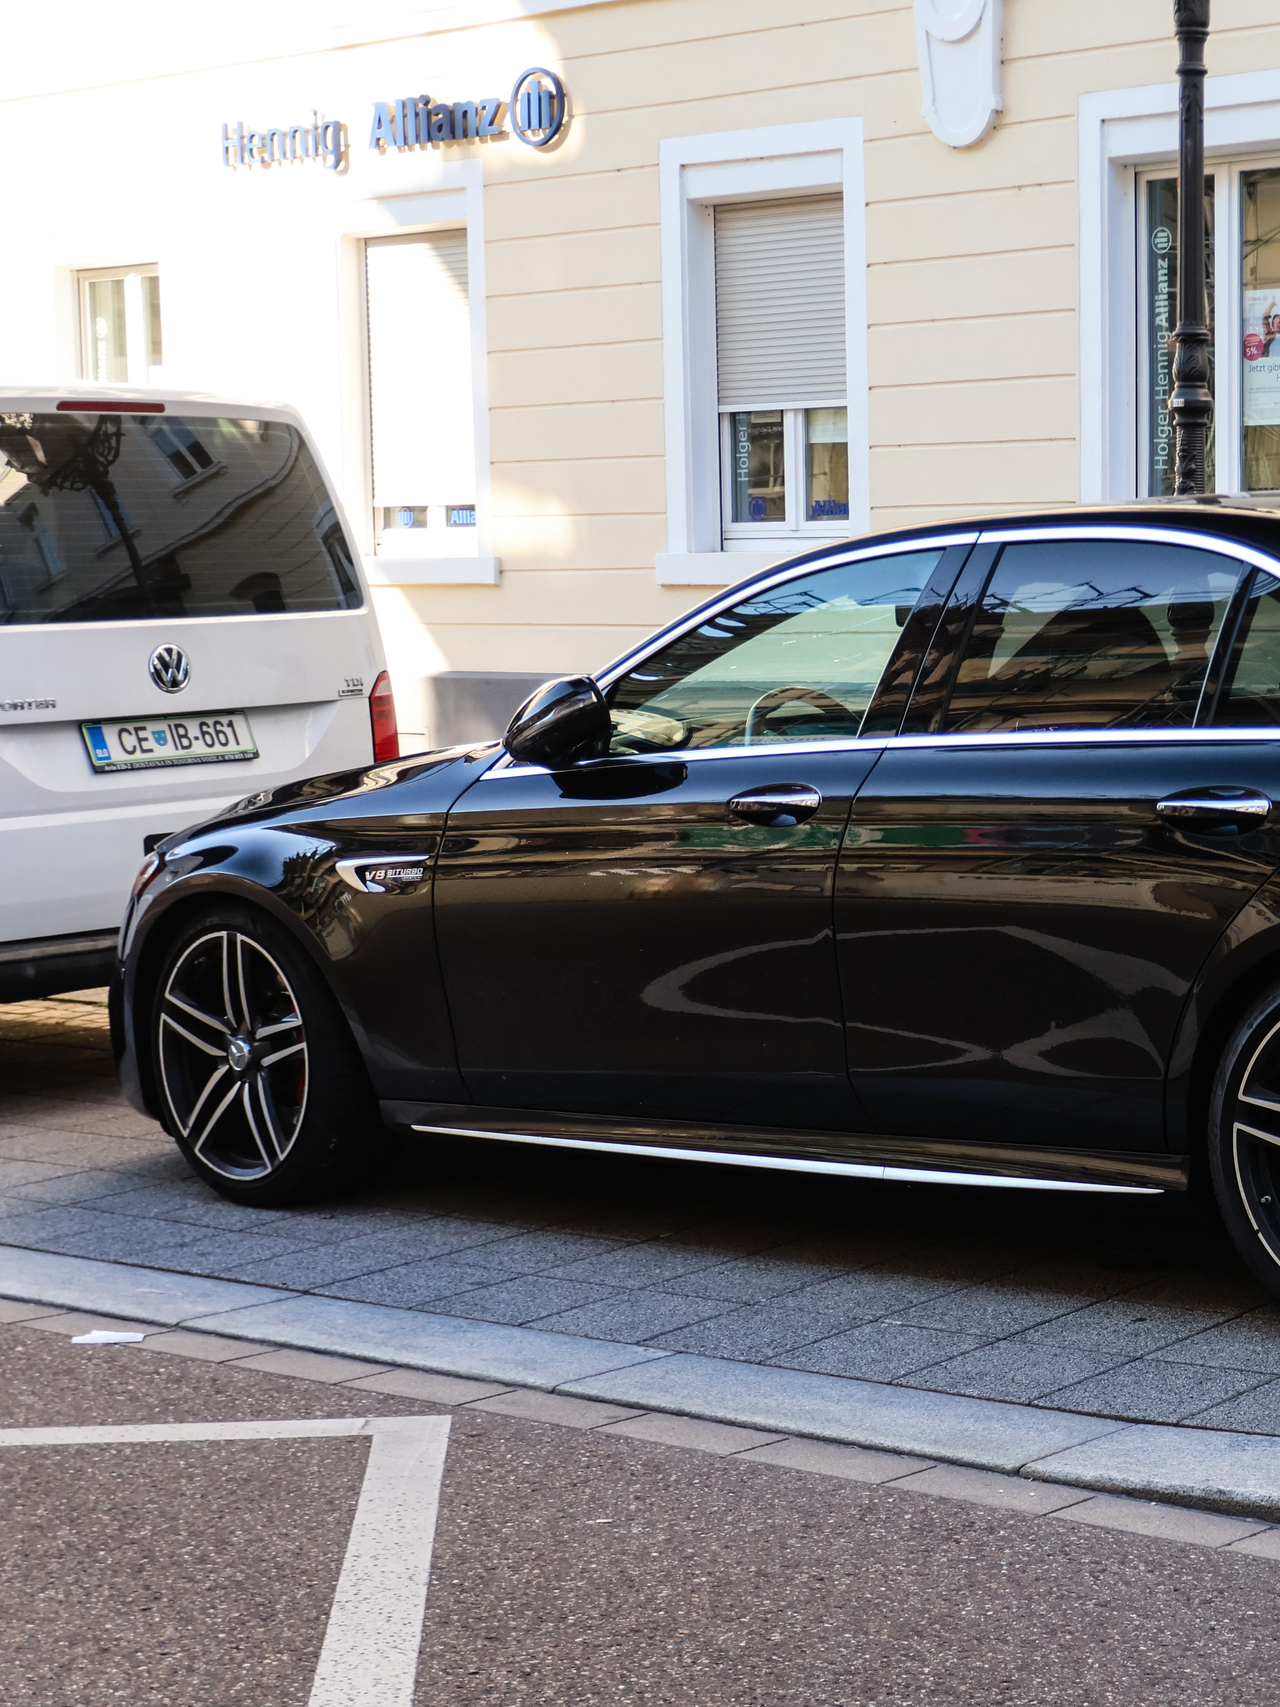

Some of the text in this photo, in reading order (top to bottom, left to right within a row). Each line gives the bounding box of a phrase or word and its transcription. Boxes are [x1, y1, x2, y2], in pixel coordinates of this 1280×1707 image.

[222, 94, 502, 170] Hennig Allianz
[1154, 257, 1173, 469] Holger Hennig Allianz
[1249, 364, 1266, 373] Jetzt
[736, 425, 752, 482] Holger
[118, 719, 240, 755] CE IB-661
[365, 868, 424, 880] V8 BITURBO
